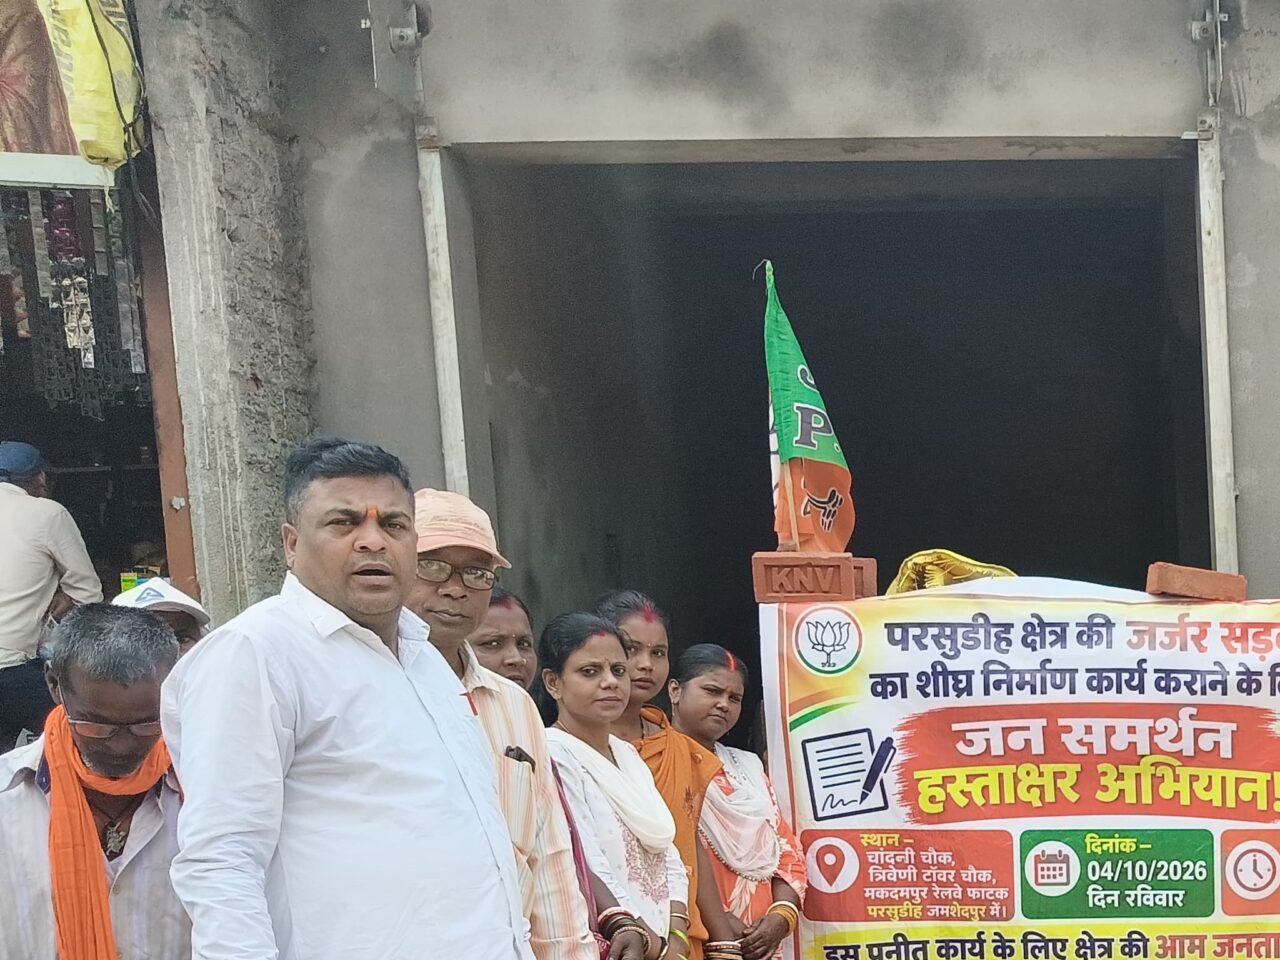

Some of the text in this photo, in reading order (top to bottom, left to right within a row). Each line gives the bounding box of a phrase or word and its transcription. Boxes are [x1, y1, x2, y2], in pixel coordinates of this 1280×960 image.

[771, 567, 835, 593] KNV
[884, 612, 1014, 660] परसुडीह
[1022, 612, 1069, 652] क्षेत्र
[1076, 613, 1115, 649] की
[1126, 613, 1211, 653] जर्जर
[869, 672, 909, 699] का
[916, 660, 974, 698] शीघ्र
[981, 658, 1078, 696] निर्माण
[1085, 658, 1147, 694] कार्य
[1154, 661, 1229, 696] कराने
[1236, 663, 1262, 696] के
[951, 708, 1237, 758] जन समर्थन
[914, 762, 1081, 814] हस्ताक्षर
[866, 847, 956, 866] चांदनी चौक,
[868, 865, 996, 884] त्रिवेणी टॉवर चौक,
[1087, 860, 1207, 881] 04/10/2026
[864, 884, 1009, 904] मकदमपुर रेलवे फाटक
[1087, 884, 1185, 908] दिन रविवार
[867, 902, 922, 921] परसुडीह
[927, 903, 986, 921] जमशेदपुर
[935, 931, 985, 960] कार्य
[992, 932, 1020, 959] के
[1021, 931, 1068, 960] लिए
[1075, 930, 1114, 960] क्षेत्र
[1120, 930, 1149, 958] की
[1155, 935, 1207, 958] आम
